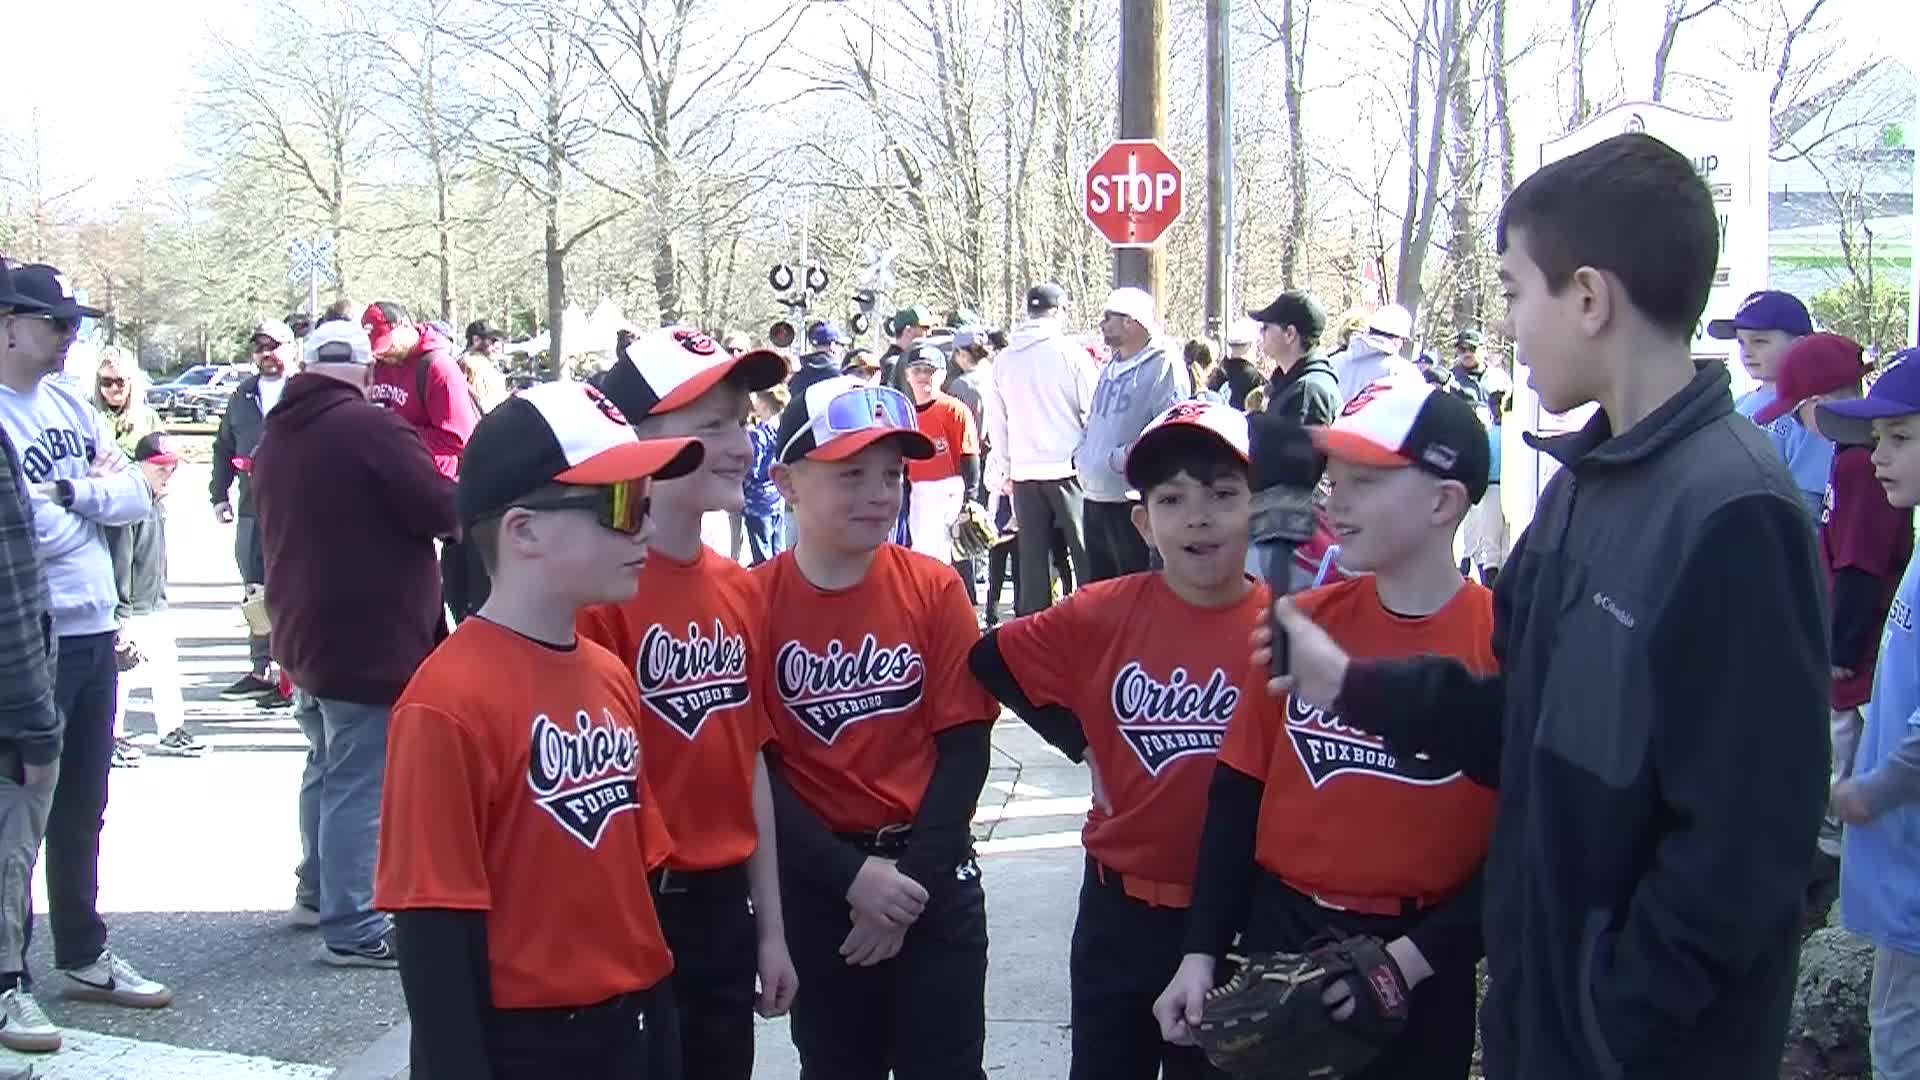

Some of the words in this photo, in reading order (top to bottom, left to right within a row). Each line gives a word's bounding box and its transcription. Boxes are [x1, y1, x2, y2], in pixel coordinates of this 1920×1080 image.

[1090, 172, 1177, 214] STOP
[1602, 597, 1635, 628] Columbia
[775, 633, 914, 702] Orioles
[806, 694, 883, 726] FOXBORO
[1112, 661, 1240, 723] Oriole
